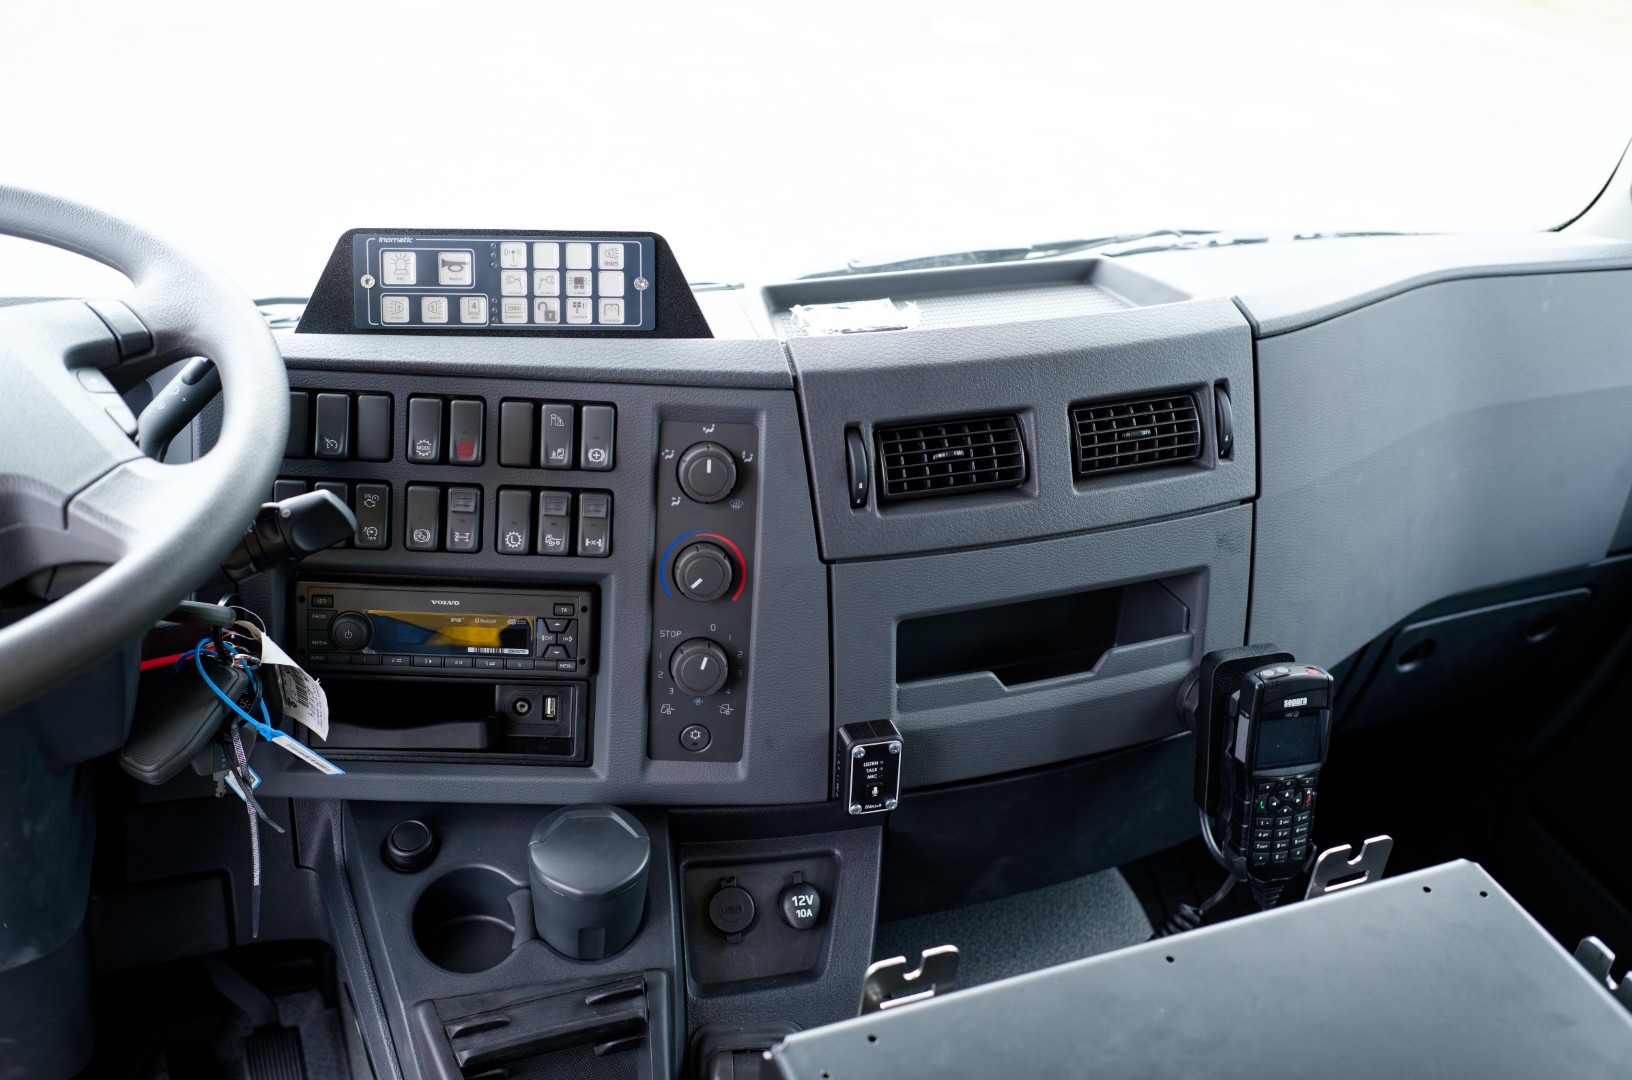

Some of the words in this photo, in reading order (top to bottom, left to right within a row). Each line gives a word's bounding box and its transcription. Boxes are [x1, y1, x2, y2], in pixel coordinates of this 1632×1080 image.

[510, 536, 517, 544] L
[710, 623, 717, 632] 0
[659, 630, 682, 638] STOP
[737, 650, 743, 659] 2
[657, 670, 664, 679] 2
[737, 669, 743, 678] 3
[668, 687, 674, 695] 3
[791, 895, 814, 906] 12V
[721, 904, 742, 915] USB
[795, 909, 813, 918] 10A
